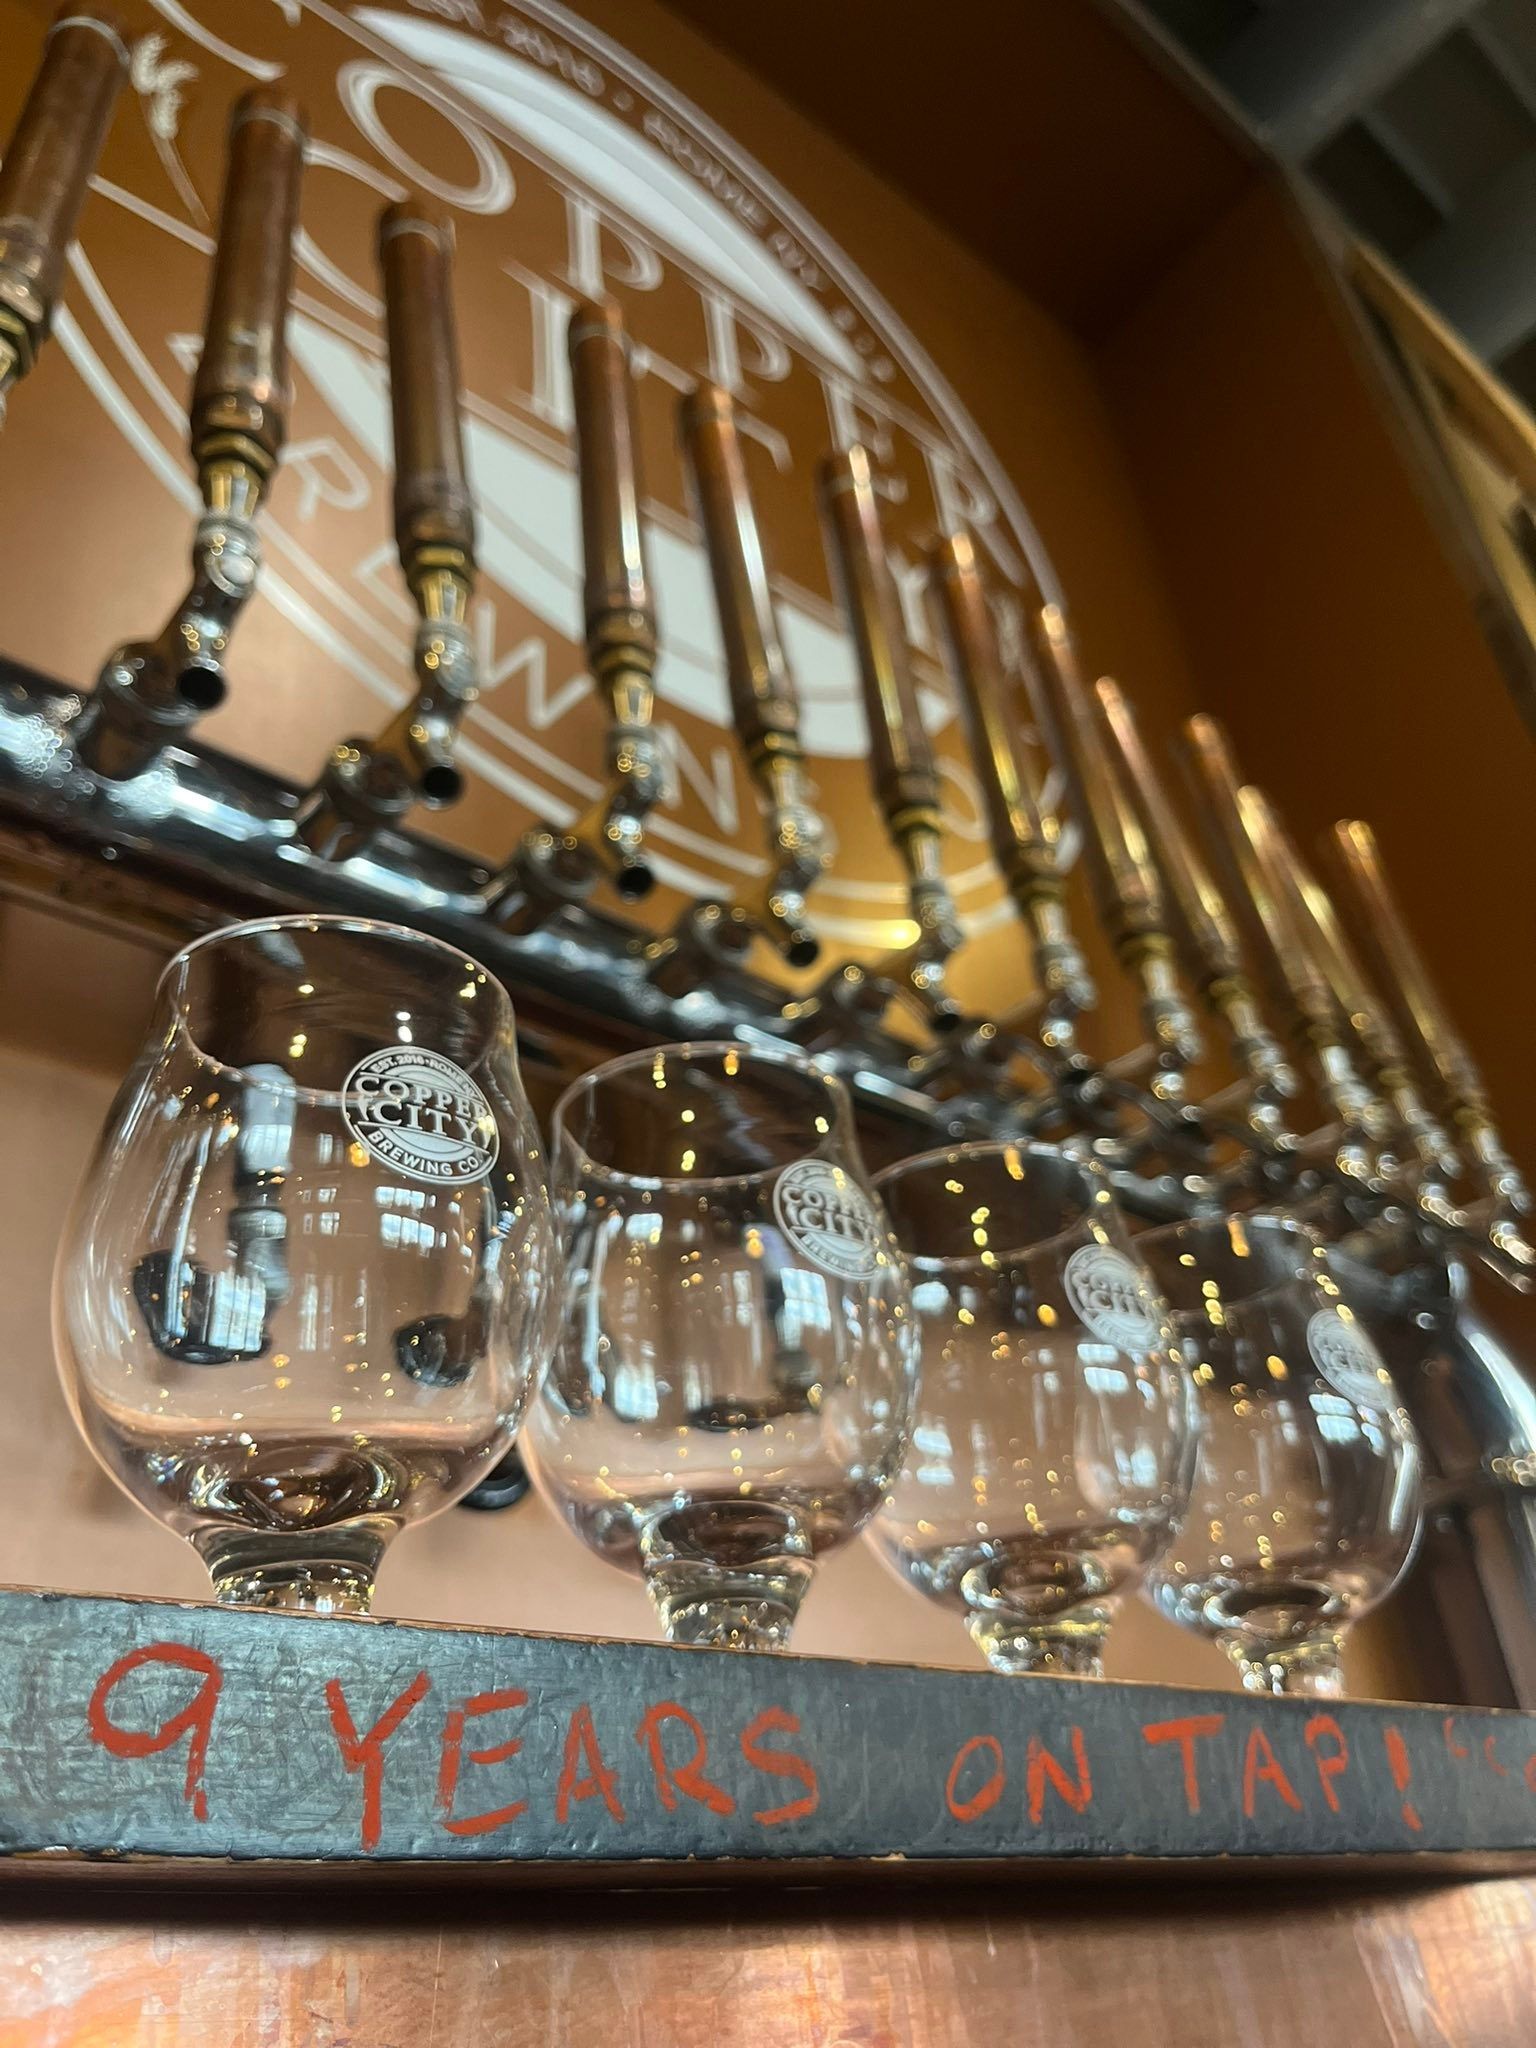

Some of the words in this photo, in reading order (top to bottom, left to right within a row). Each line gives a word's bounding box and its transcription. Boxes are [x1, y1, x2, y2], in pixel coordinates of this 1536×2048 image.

[372, 1101, 480, 1145] CITY
[368, 1130, 453, 1176] BREWING
[87, 1641, 225, 1823] 9
[324, 1670, 822, 1853] YEARS
[944, 1723, 1093, 1825] ON
[1142, 1713, 1424, 1833] TAP!
